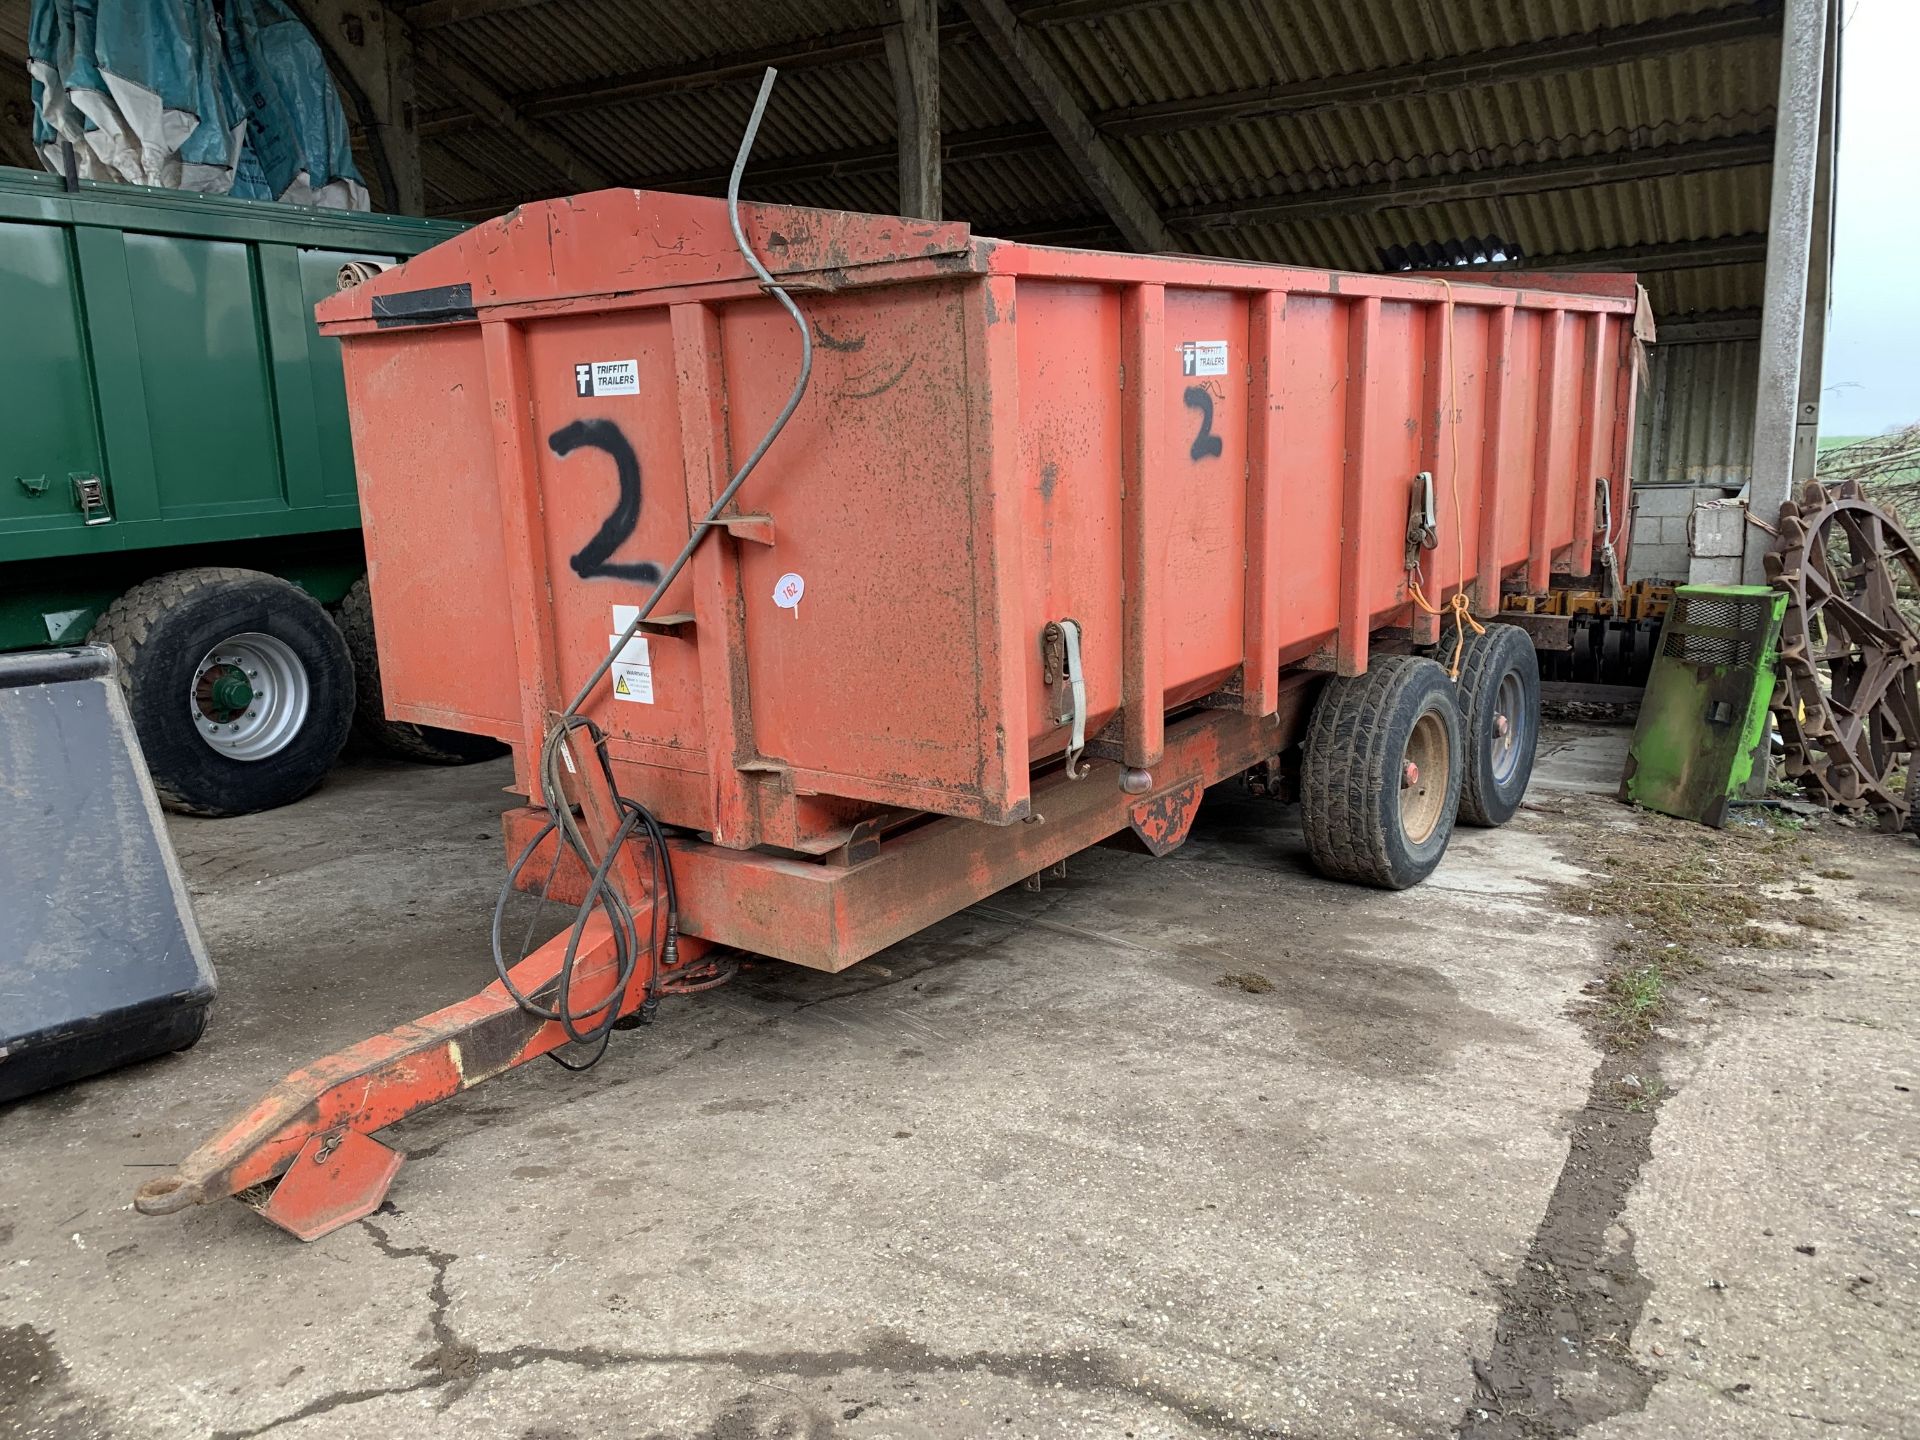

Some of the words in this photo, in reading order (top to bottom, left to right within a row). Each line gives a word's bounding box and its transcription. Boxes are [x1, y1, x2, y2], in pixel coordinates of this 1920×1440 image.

[1200, 357, 1225, 366] TRAILERS
[597, 364, 629, 374] TRIFFITT
[598, 375, 635, 386] TRAILERS
[1183, 387, 1222, 461] 2
[548, 419, 662, 583] 2
[782, 582, 798, 600] 162
